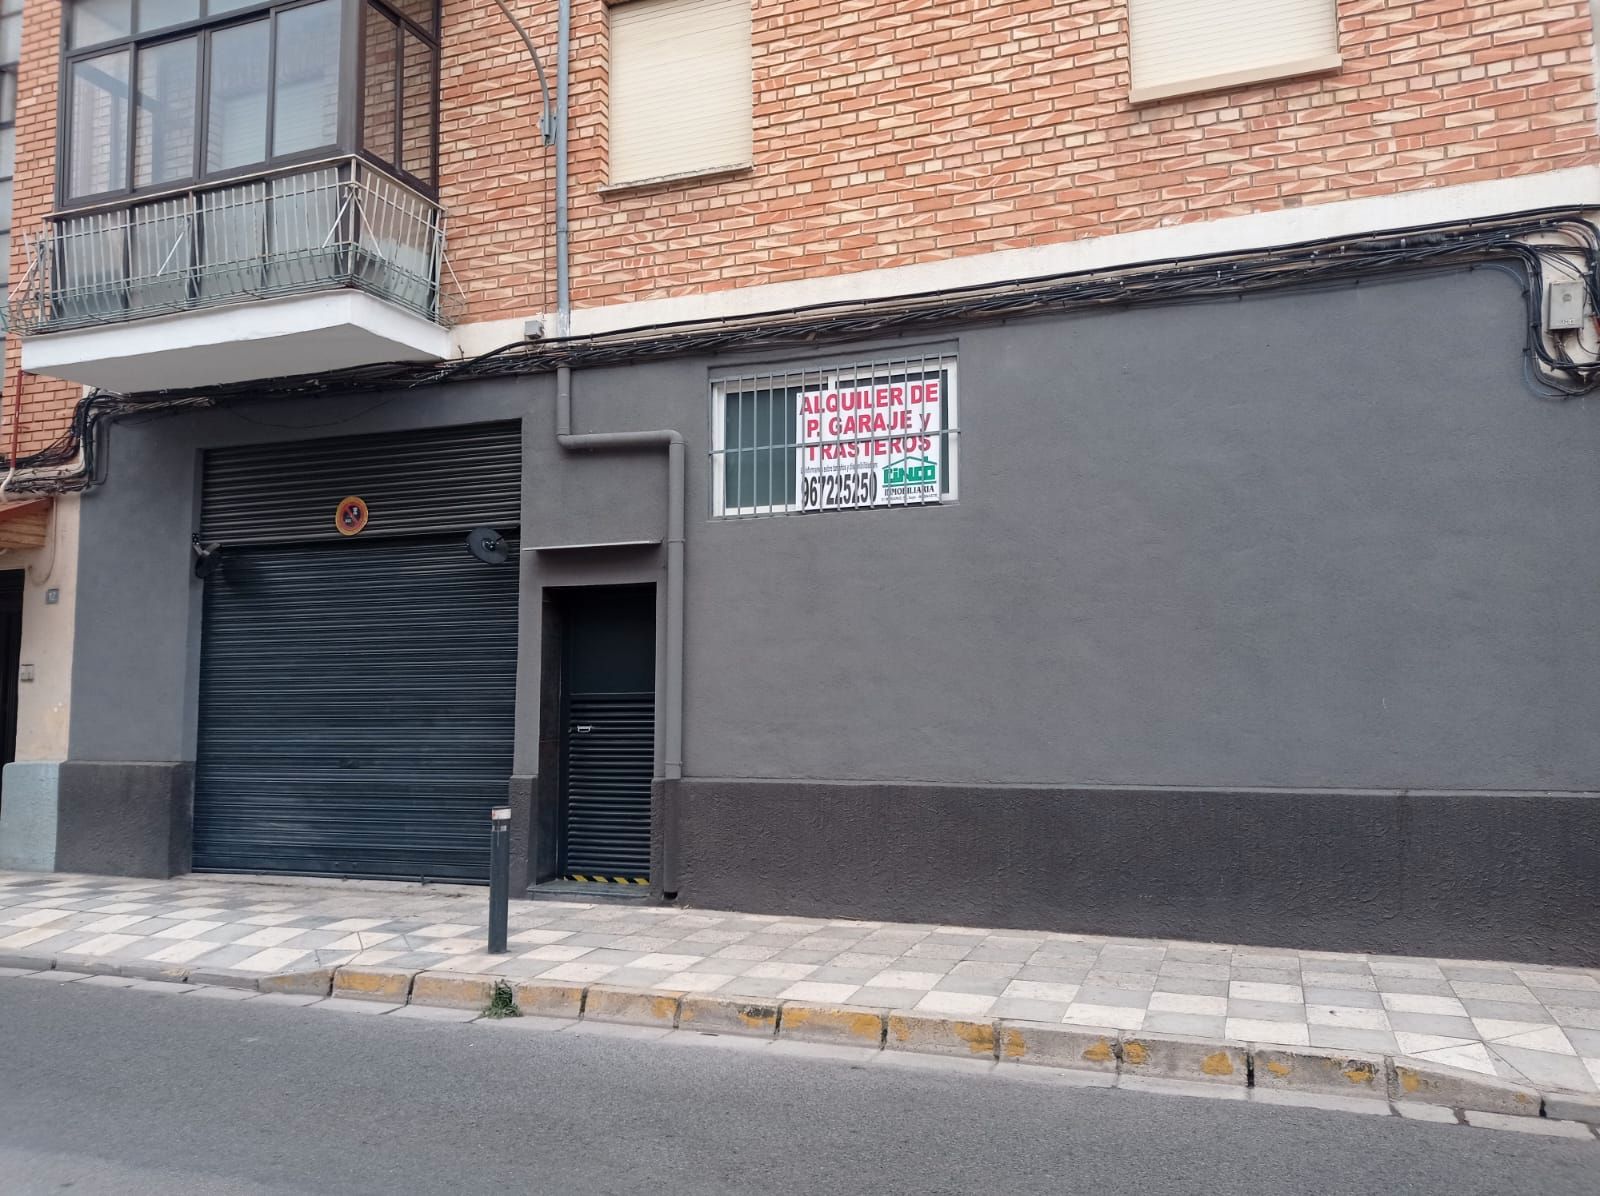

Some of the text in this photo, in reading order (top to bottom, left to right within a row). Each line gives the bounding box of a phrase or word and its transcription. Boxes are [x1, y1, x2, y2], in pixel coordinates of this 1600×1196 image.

[799, 383, 938, 415] ALQUILER DE
[807, 419, 820, 438] P.
[828, 410, 913, 436] GARAJE
[806, 435, 932, 461] TRASTEROS
[801, 472, 877, 507] 967225250
